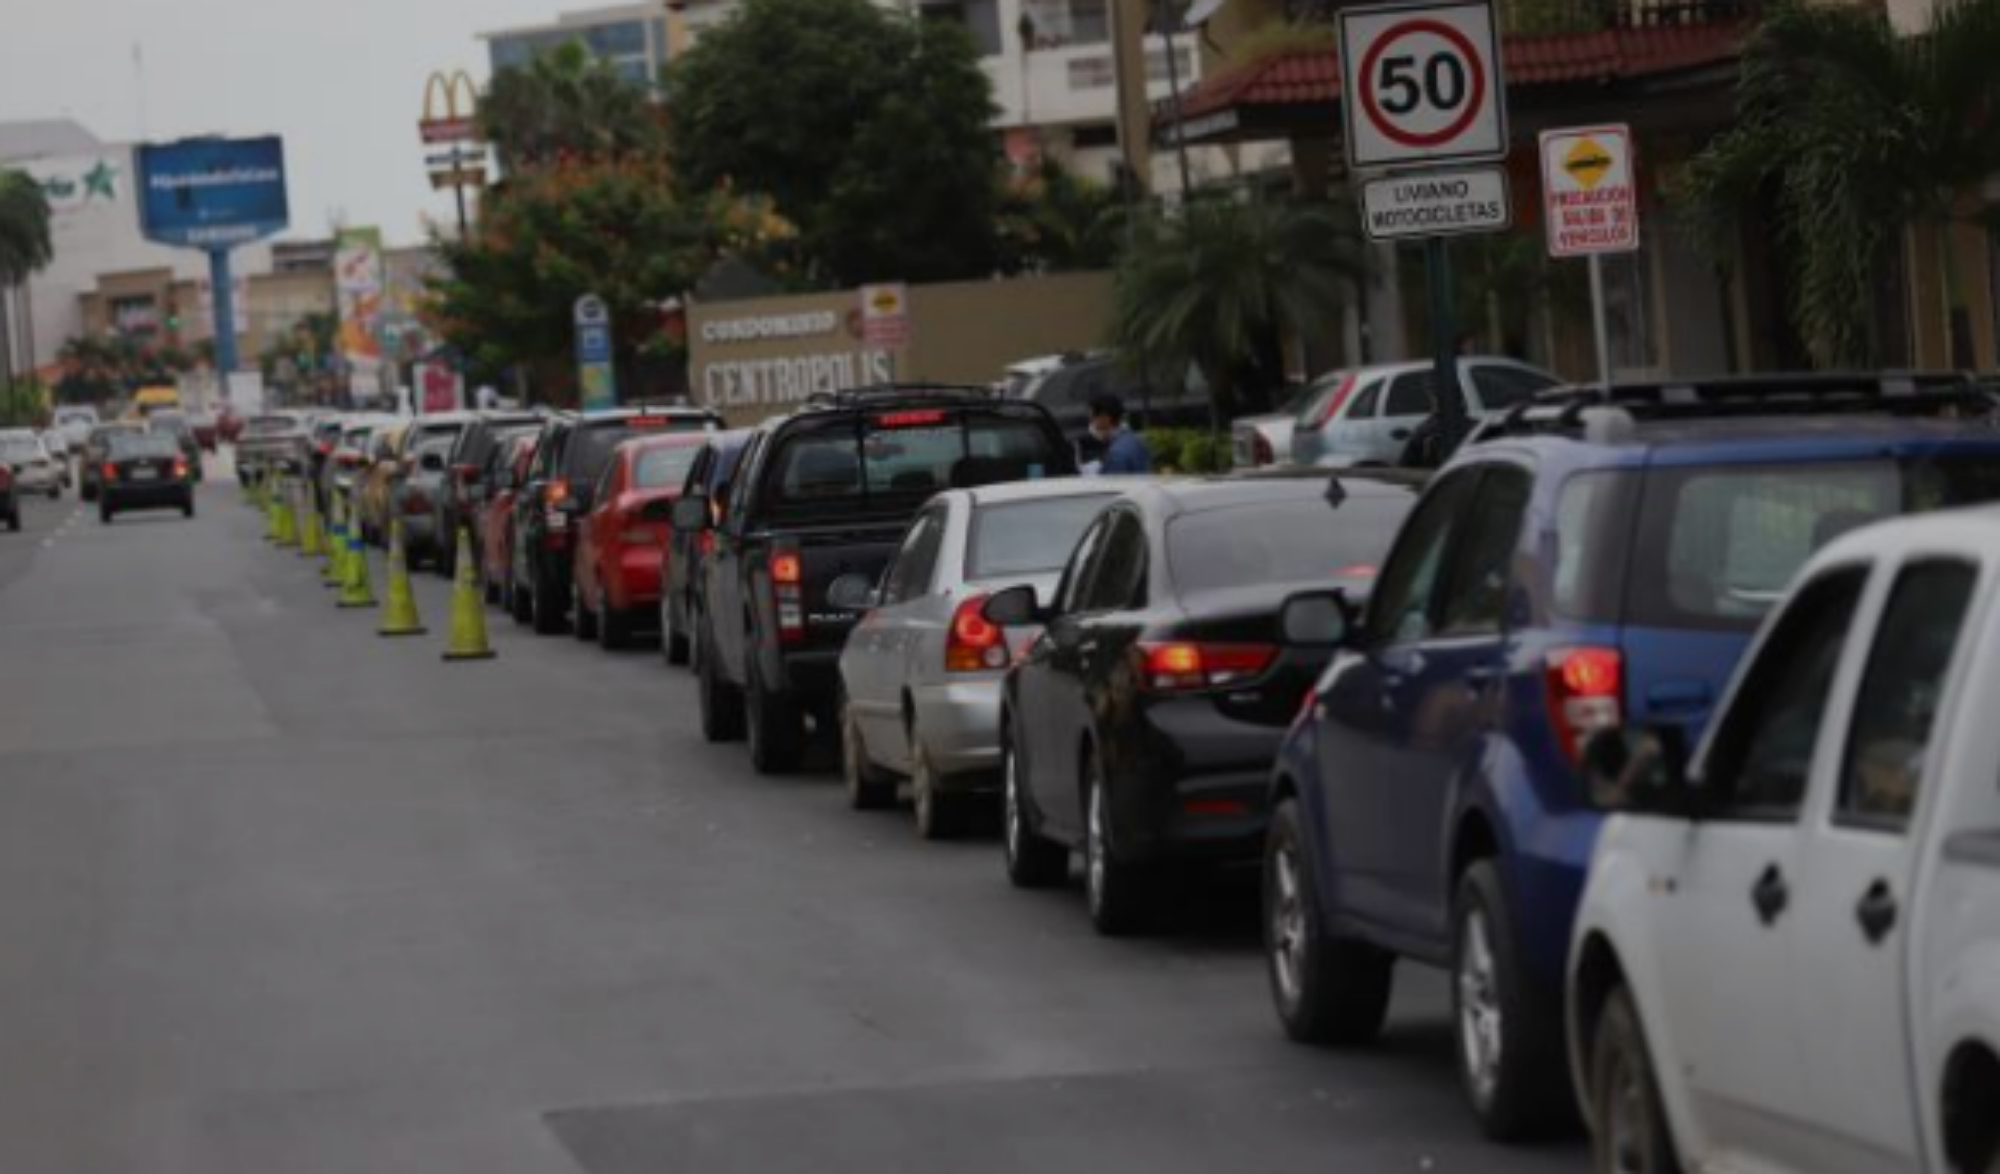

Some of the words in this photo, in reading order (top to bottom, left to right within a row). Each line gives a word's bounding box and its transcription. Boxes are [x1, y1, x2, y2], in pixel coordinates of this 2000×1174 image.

[1379, 52, 1465, 114] 50
[1394, 179, 1469, 201] LIVIANO
[1372, 201, 1500, 228] MOTOCICLETAS
[703, 311, 836, 340] CONDOMINIO
